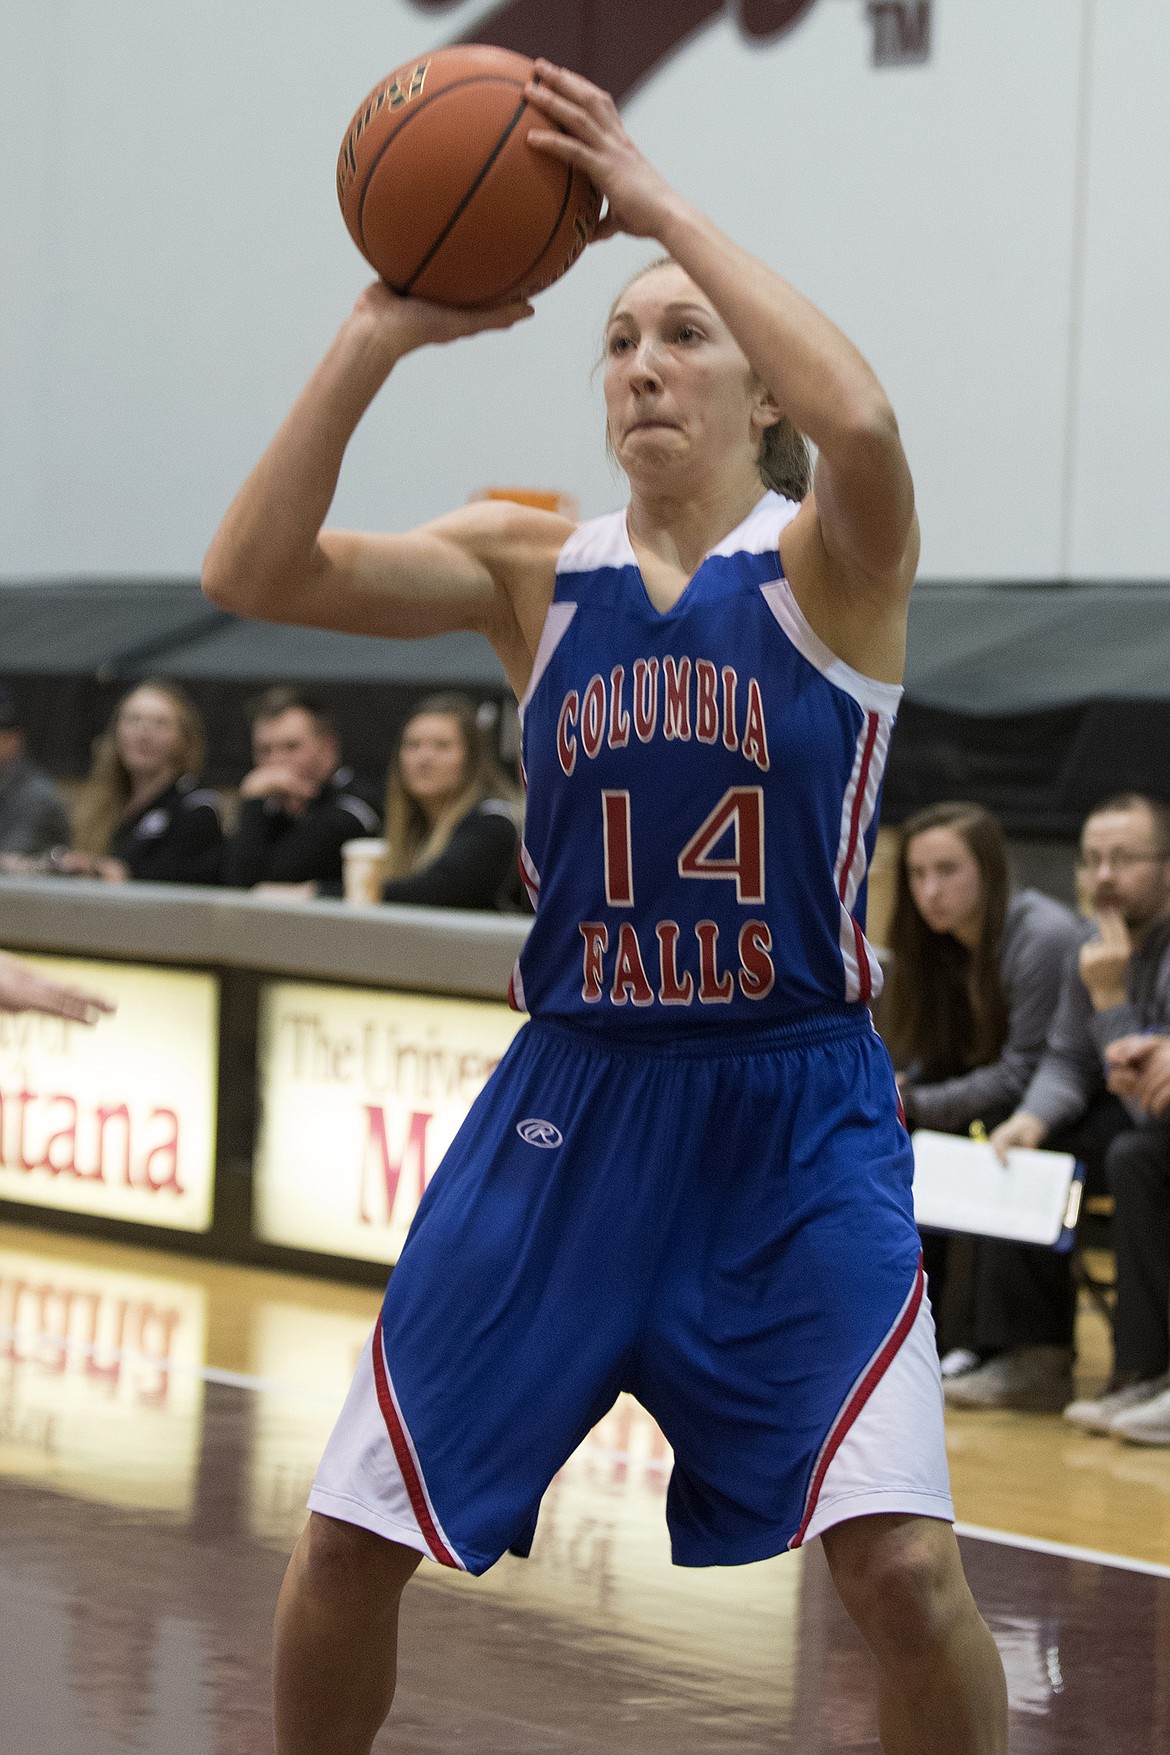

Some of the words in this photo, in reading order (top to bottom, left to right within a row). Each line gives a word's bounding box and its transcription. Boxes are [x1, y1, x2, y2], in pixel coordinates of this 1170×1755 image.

[557, 655, 770, 776] COLUMBIA
[601, 785, 765, 908] 14
[579, 919, 775, 1007] FALLS
[280, 1012, 352, 1083] The
[0, 1068, 185, 1196] tana
